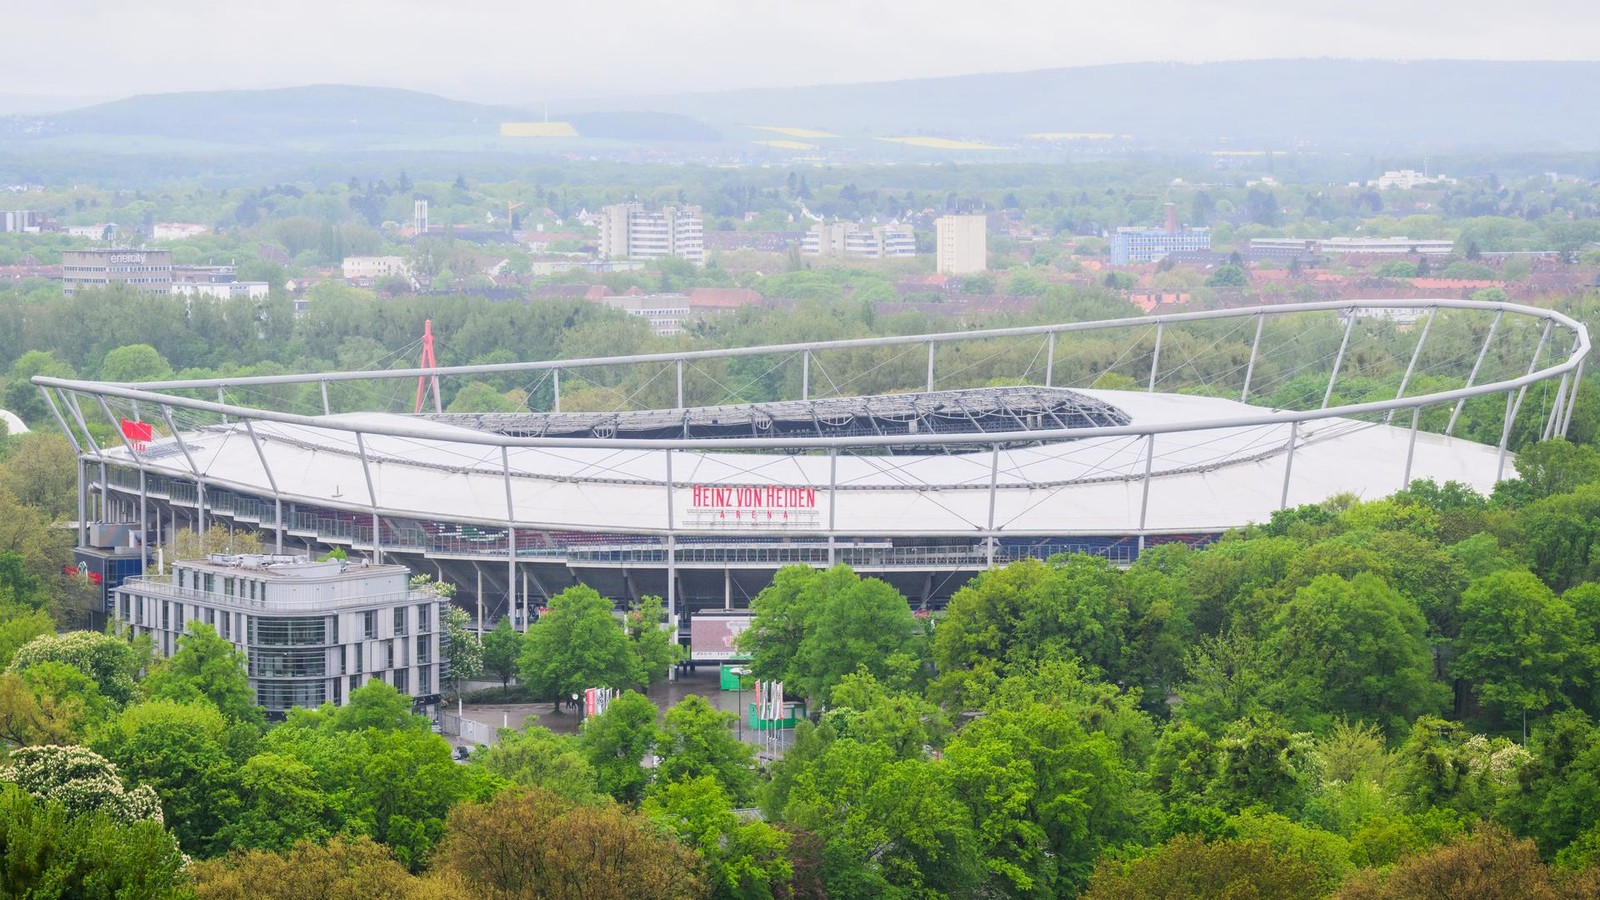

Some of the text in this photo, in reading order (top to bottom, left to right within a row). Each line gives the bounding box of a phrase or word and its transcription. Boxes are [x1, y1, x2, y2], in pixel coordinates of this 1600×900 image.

[693, 485, 815, 507] HEINZ VON HEIDEN
[720, 510, 788, 519] ARENA
